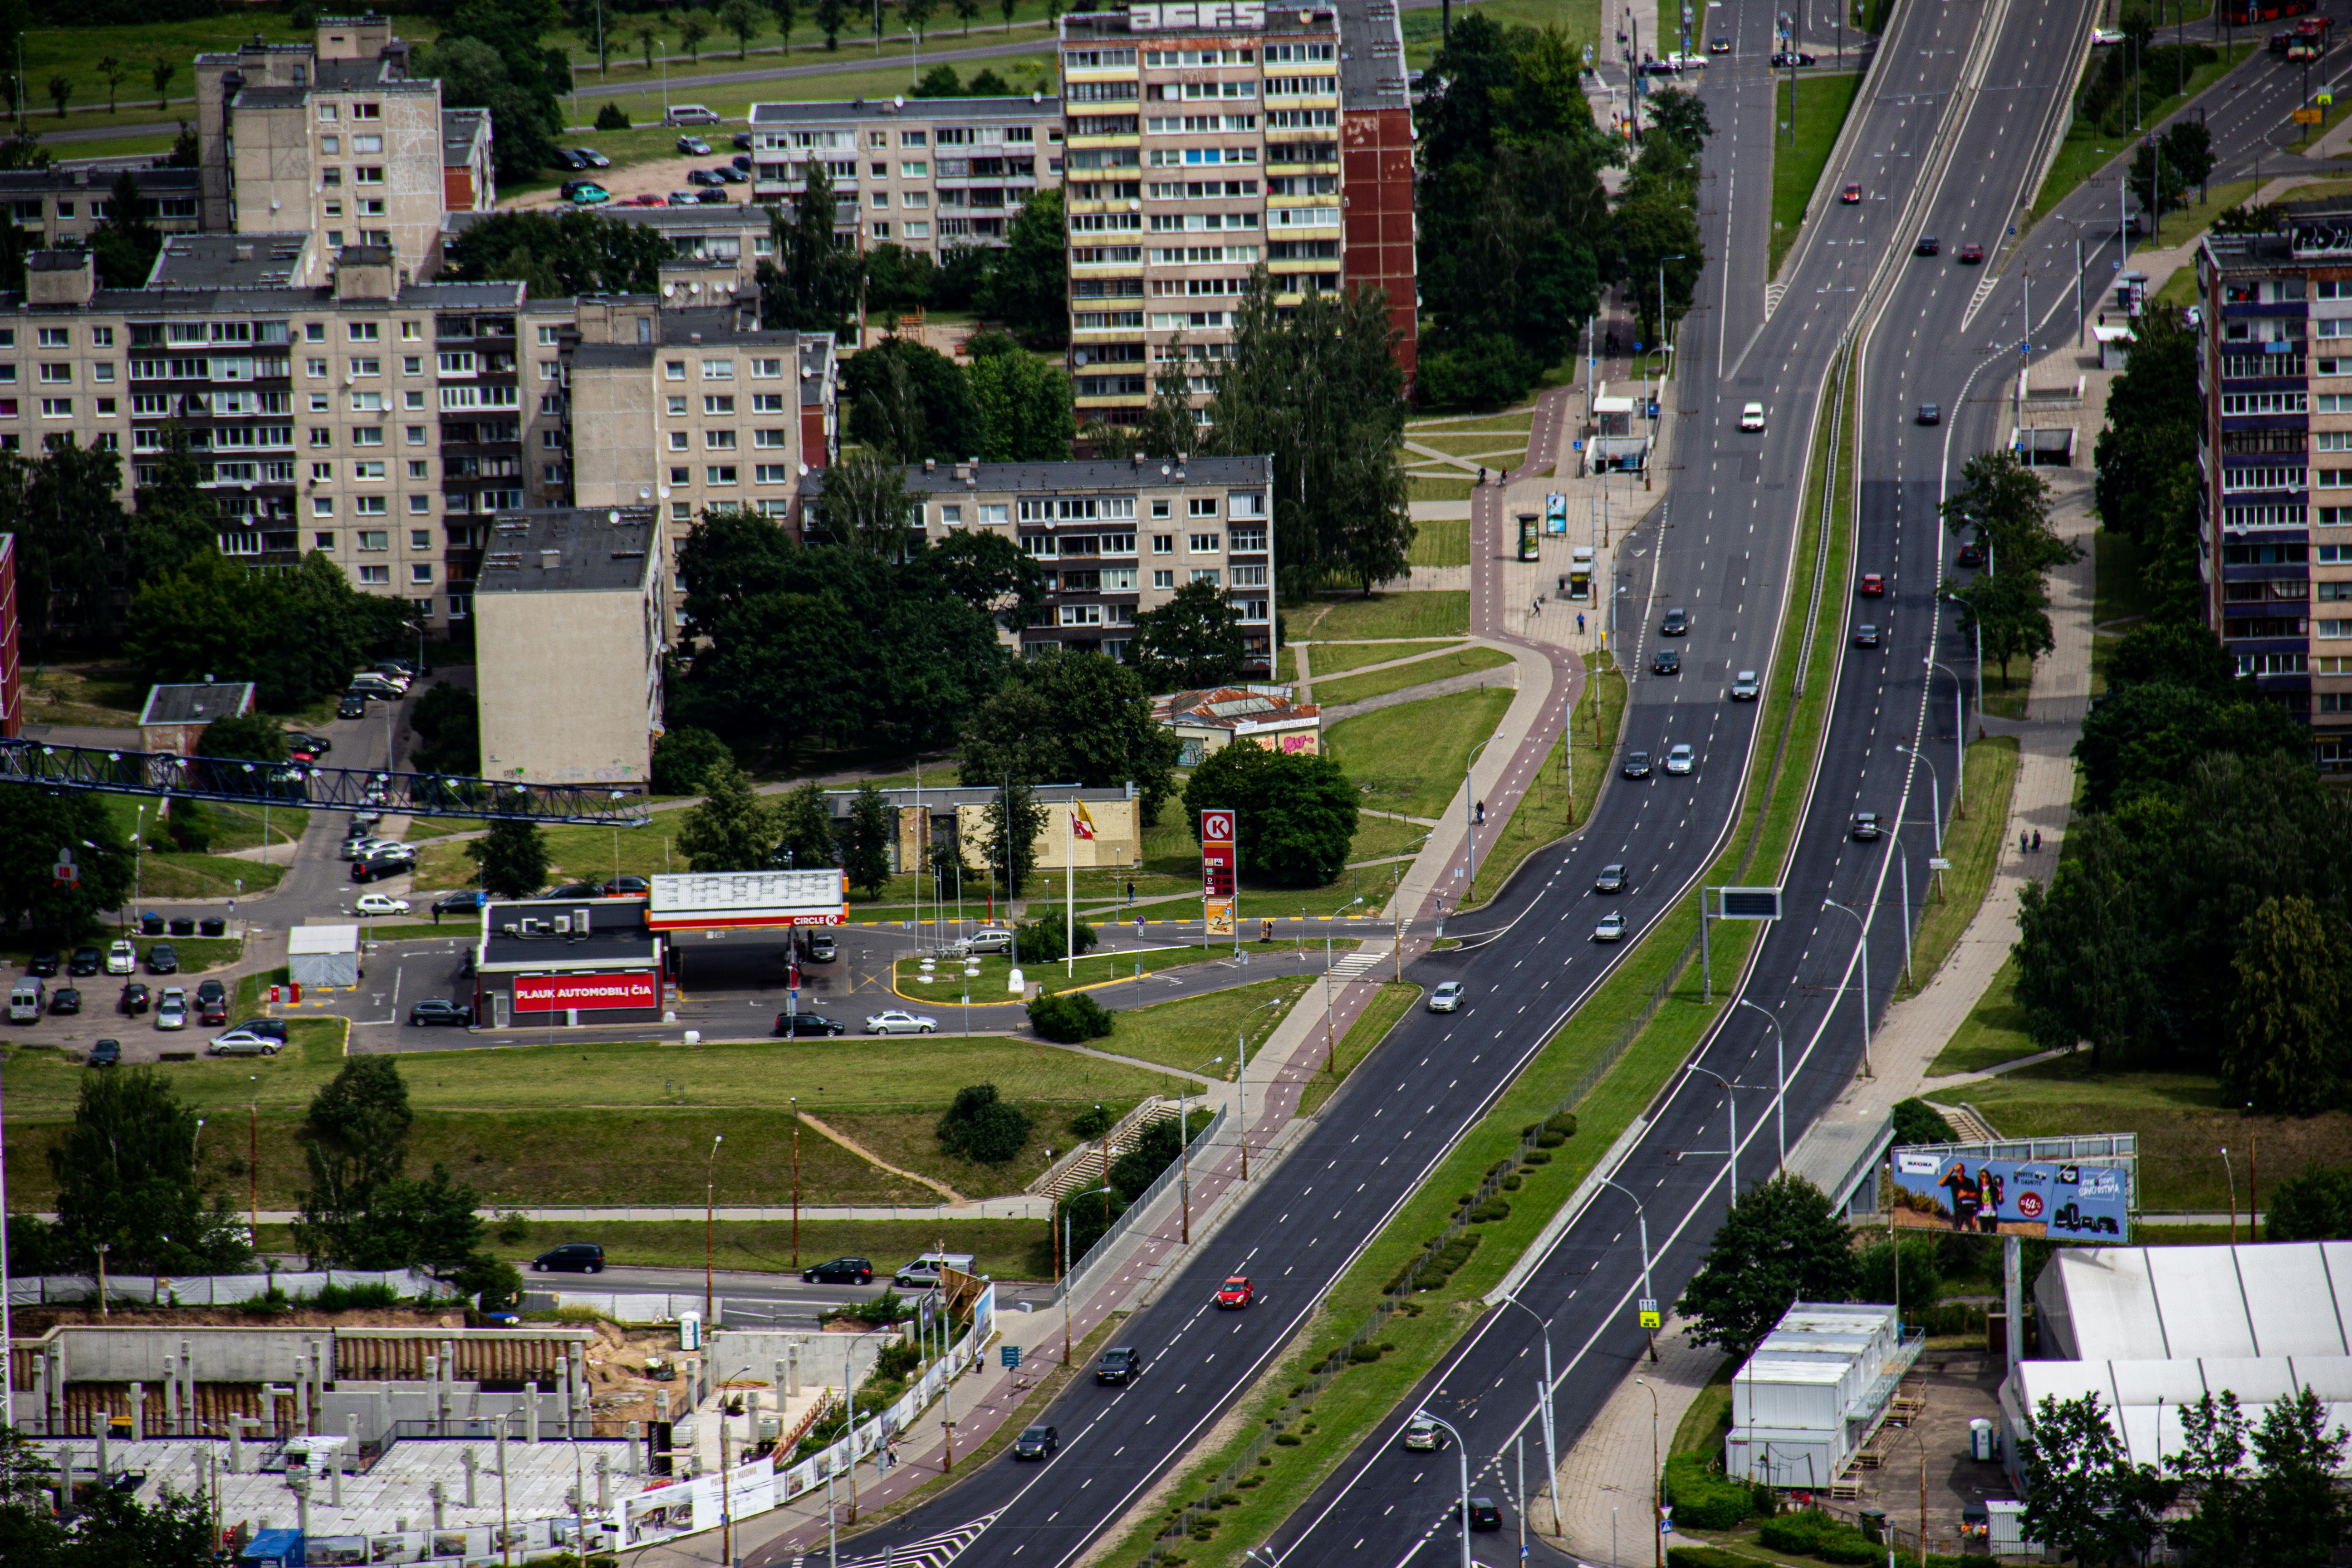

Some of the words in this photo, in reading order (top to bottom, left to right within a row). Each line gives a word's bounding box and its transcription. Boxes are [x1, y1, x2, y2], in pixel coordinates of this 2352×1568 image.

[1279, 719, 1312, 728] JUVELYRAS
[1210, 818, 1228, 838] K
[794, 917, 824, 925] CIRCLE
[516, 989, 555, 999] PLAUK
[557, 987, 628, 998] AUTOMOBILĮ
[630, 984, 652, 995] ČIA
[738, 1466, 757, 1479] NUOMA
